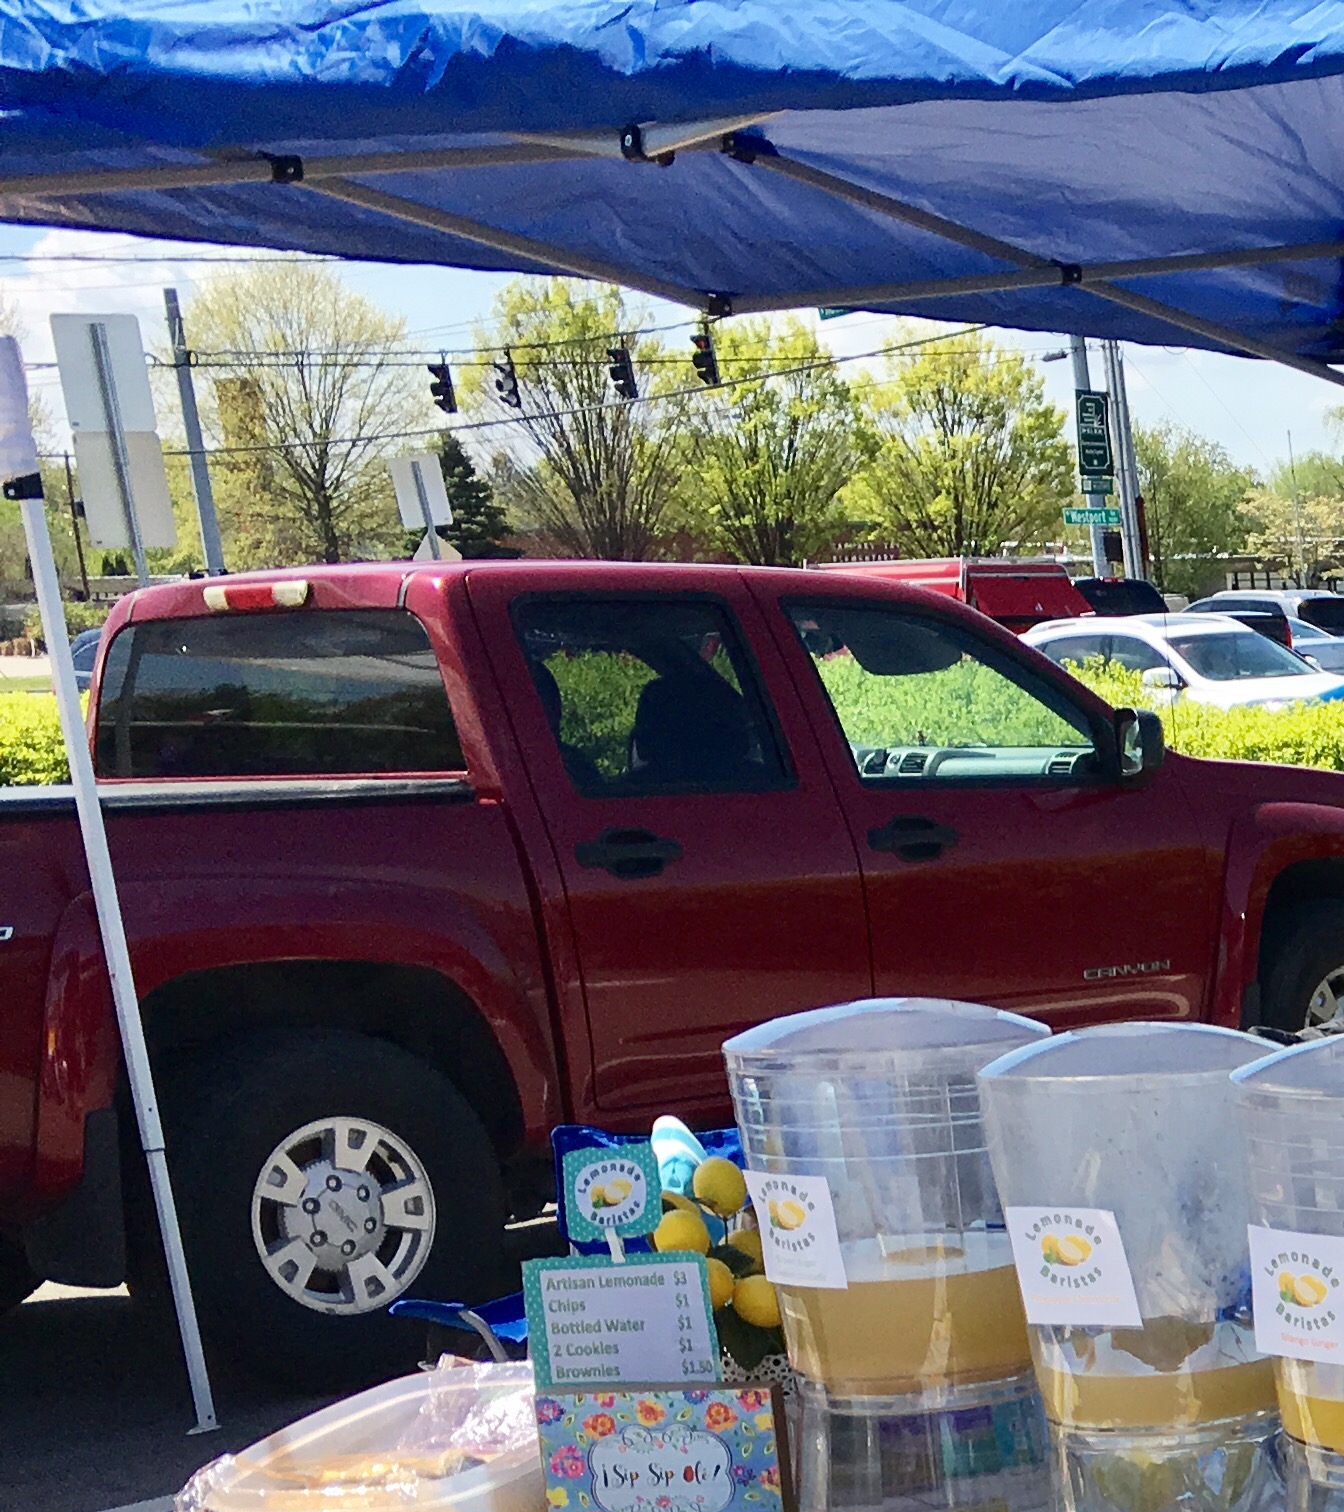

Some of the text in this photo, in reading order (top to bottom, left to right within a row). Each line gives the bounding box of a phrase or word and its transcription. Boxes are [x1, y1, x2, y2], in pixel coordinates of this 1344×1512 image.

[1070, 509, 1106, 523] Westport
[1084, 960, 1170, 979] CANYON
[578, 1163, 641, 1193] Lemonade
[759, 1181, 815, 1211] Lemonade
[590, 1201, 640, 1226] Baristas
[769, 1228, 816, 1252] Baristas
[1025, 1214, 1103, 1246] Lemonade
[546, 1271, 687, 1292] Artisan Lemonade $3
[1040, 1265, 1102, 1289] Baristas
[1264, 1251, 1340, 1288] Lemonade
[548, 1293, 690, 1315] Chips $1
[551, 1315, 693, 1335] Bottled Water $1
[1276, 1302, 1336, 1331] Baristas
[553, 1338, 694, 1357] 2 Cookies $1
[556, 1358, 713, 1379] Brownies $1.50
[647, 1462, 675, 1488] Sip
